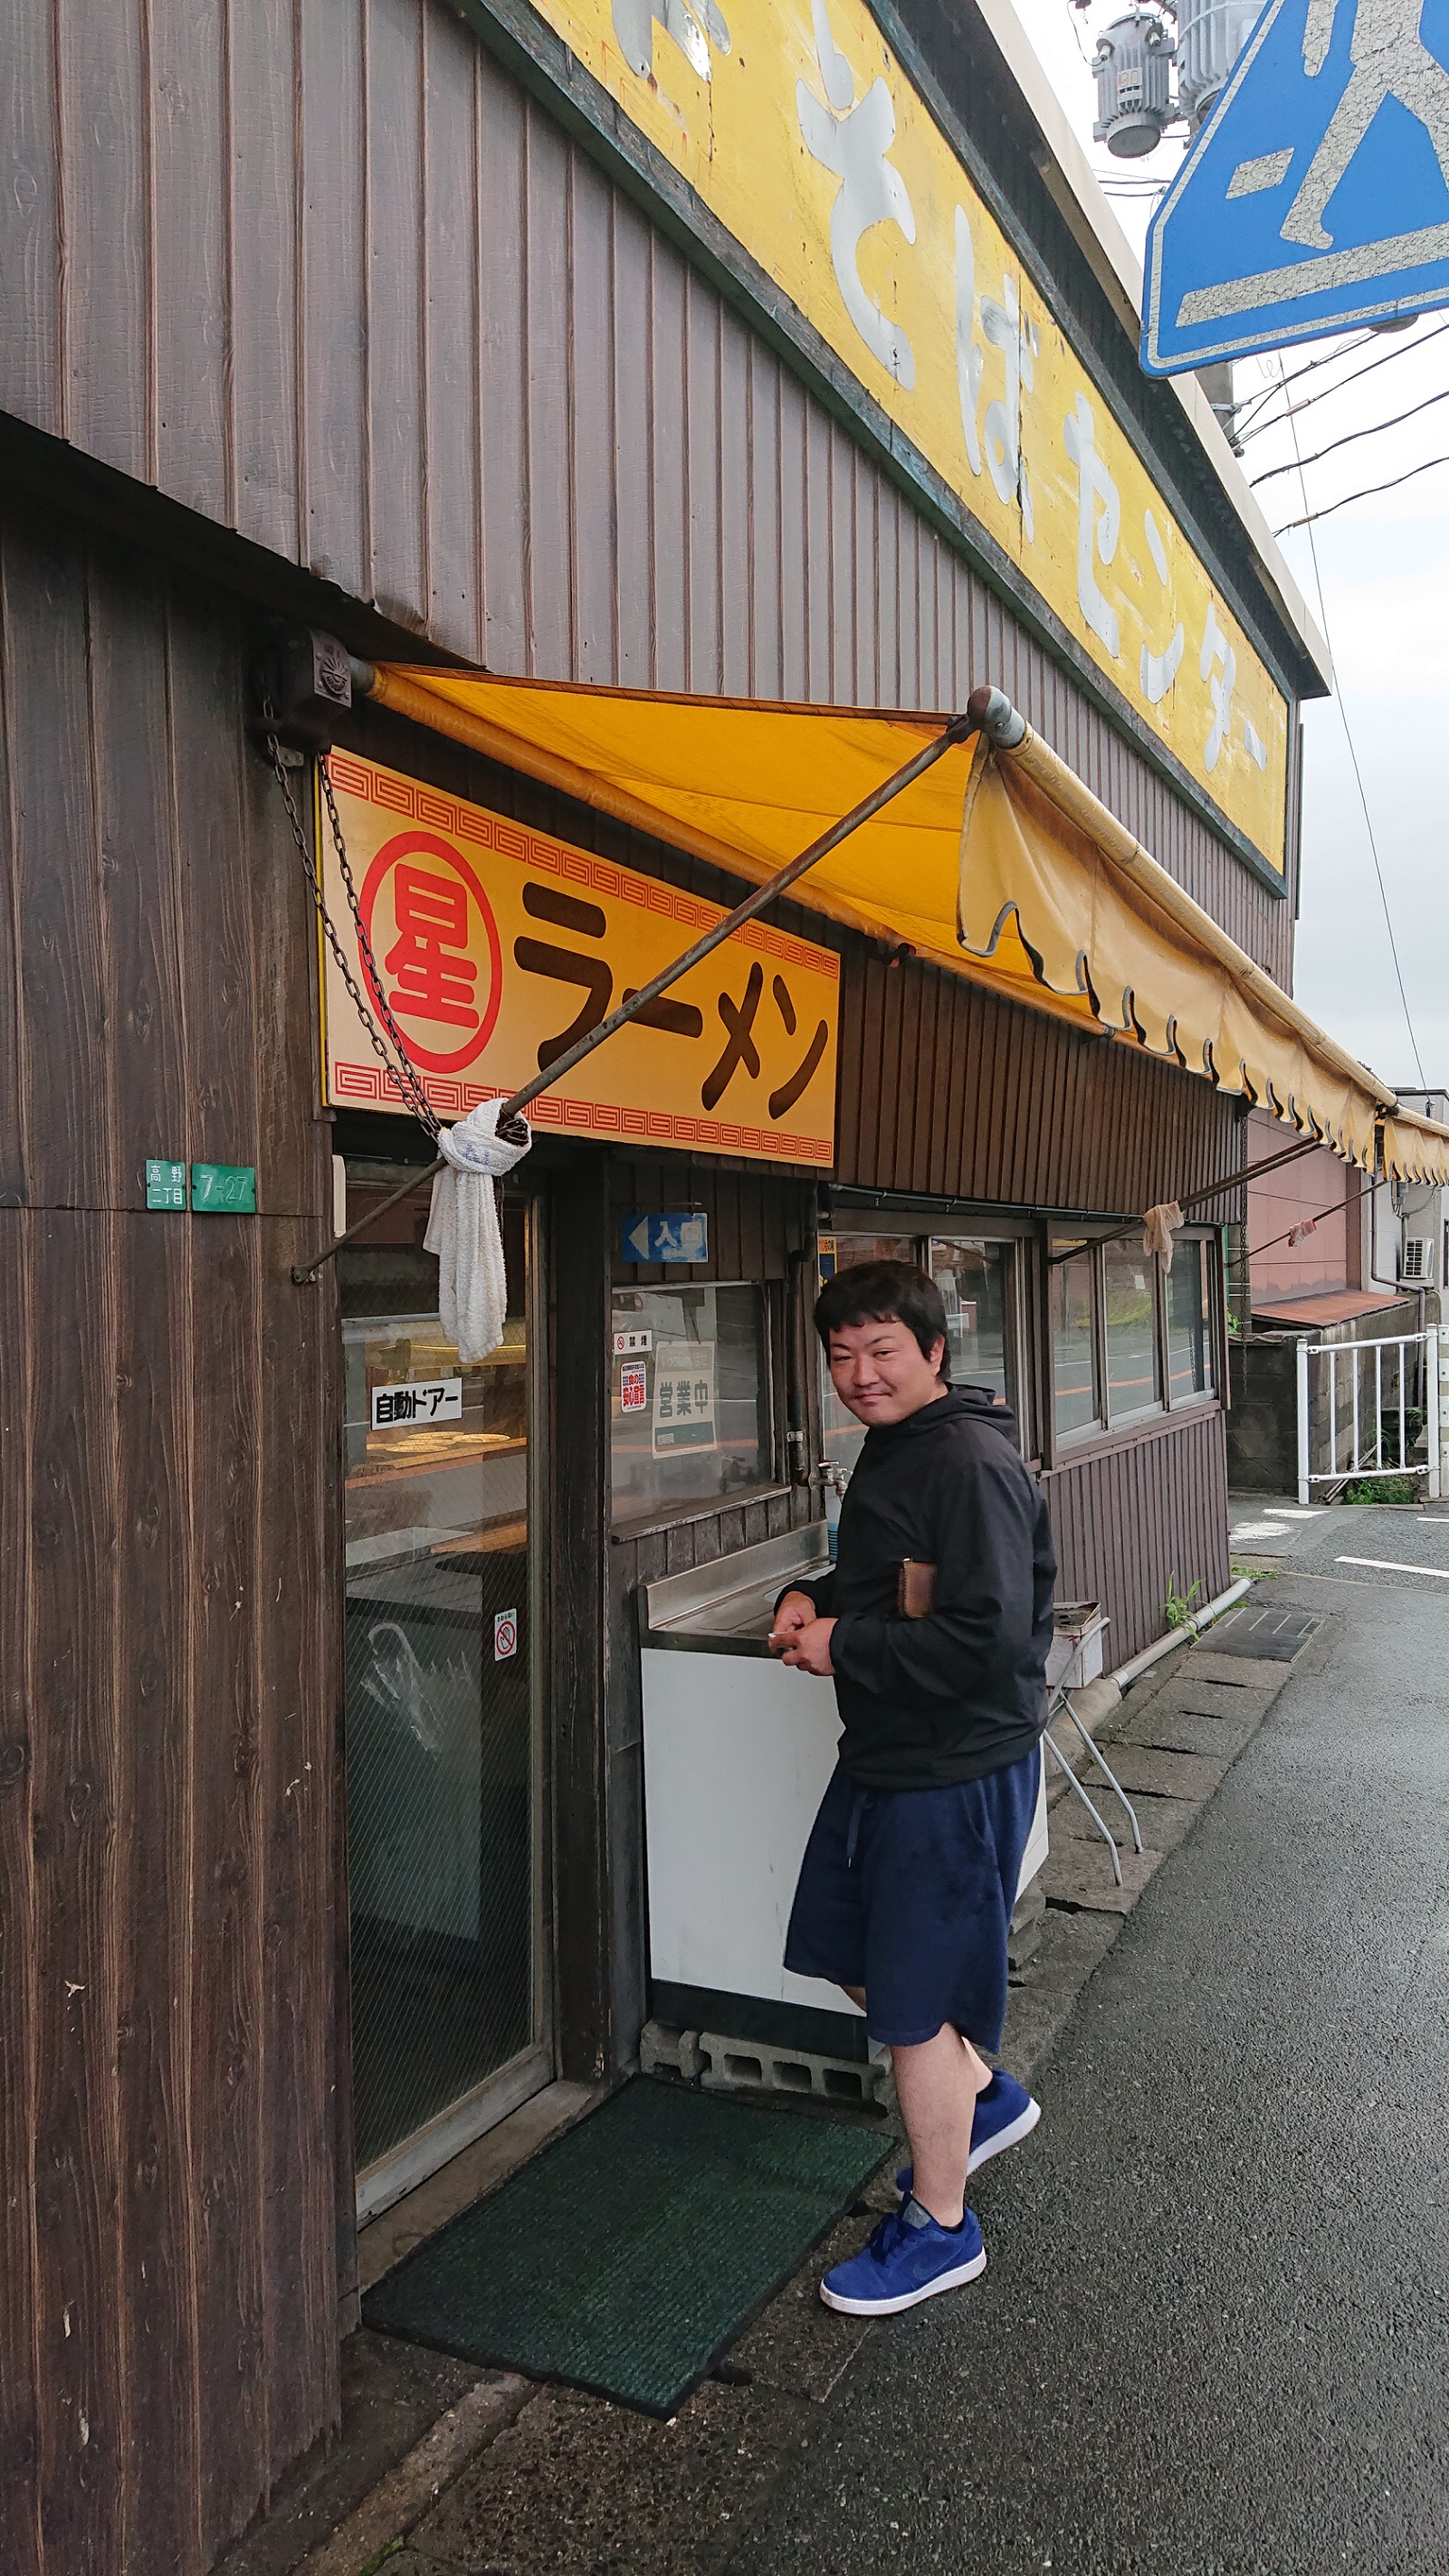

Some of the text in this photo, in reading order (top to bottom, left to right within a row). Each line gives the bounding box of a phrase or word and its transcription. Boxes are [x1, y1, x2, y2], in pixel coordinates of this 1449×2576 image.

[200, 1174, 249, 1202] 7-27
[653, 1221, 703, 1248] 入口
[376, 1387, 459, 1424] 自動ドアー
[659, 1379, 709, 1419] 営業中
